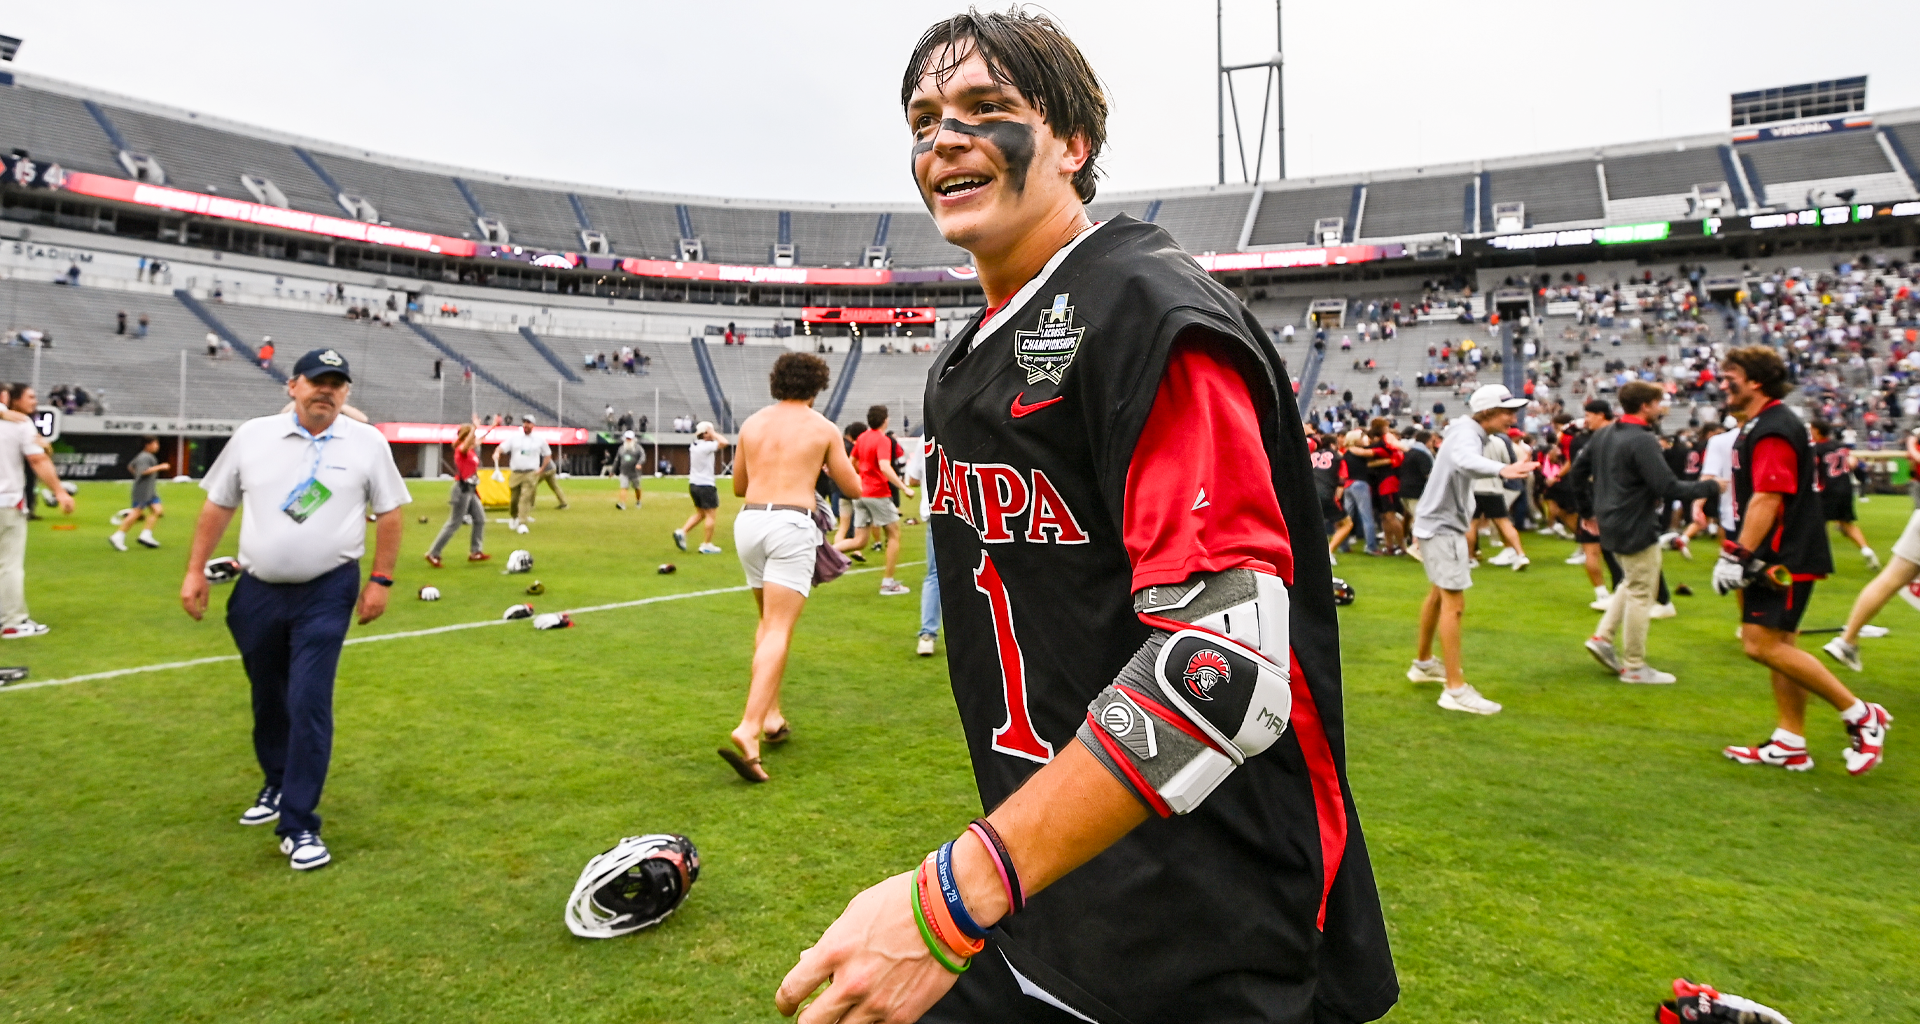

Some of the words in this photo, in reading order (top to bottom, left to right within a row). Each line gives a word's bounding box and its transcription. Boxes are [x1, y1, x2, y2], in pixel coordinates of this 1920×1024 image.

[1770, 121, 1832, 137] VIRGINIA
[719, 266, 755, 281] TAMPA
[754, 267, 808, 284] SPARTANS
[1041, 328, 1068, 338] LACROSSE
[1021, 337, 1077, 351] CHAMPIONSHIPS
[104, 420, 144, 430] DAVID
[168, 422, 234, 433] HRRISON
[924, 436, 1090, 543] AMPA
[973, 548, 1055, 765] 1
[940, 862, 951, 891] Strong
[946, 889, 959, 904] 29
